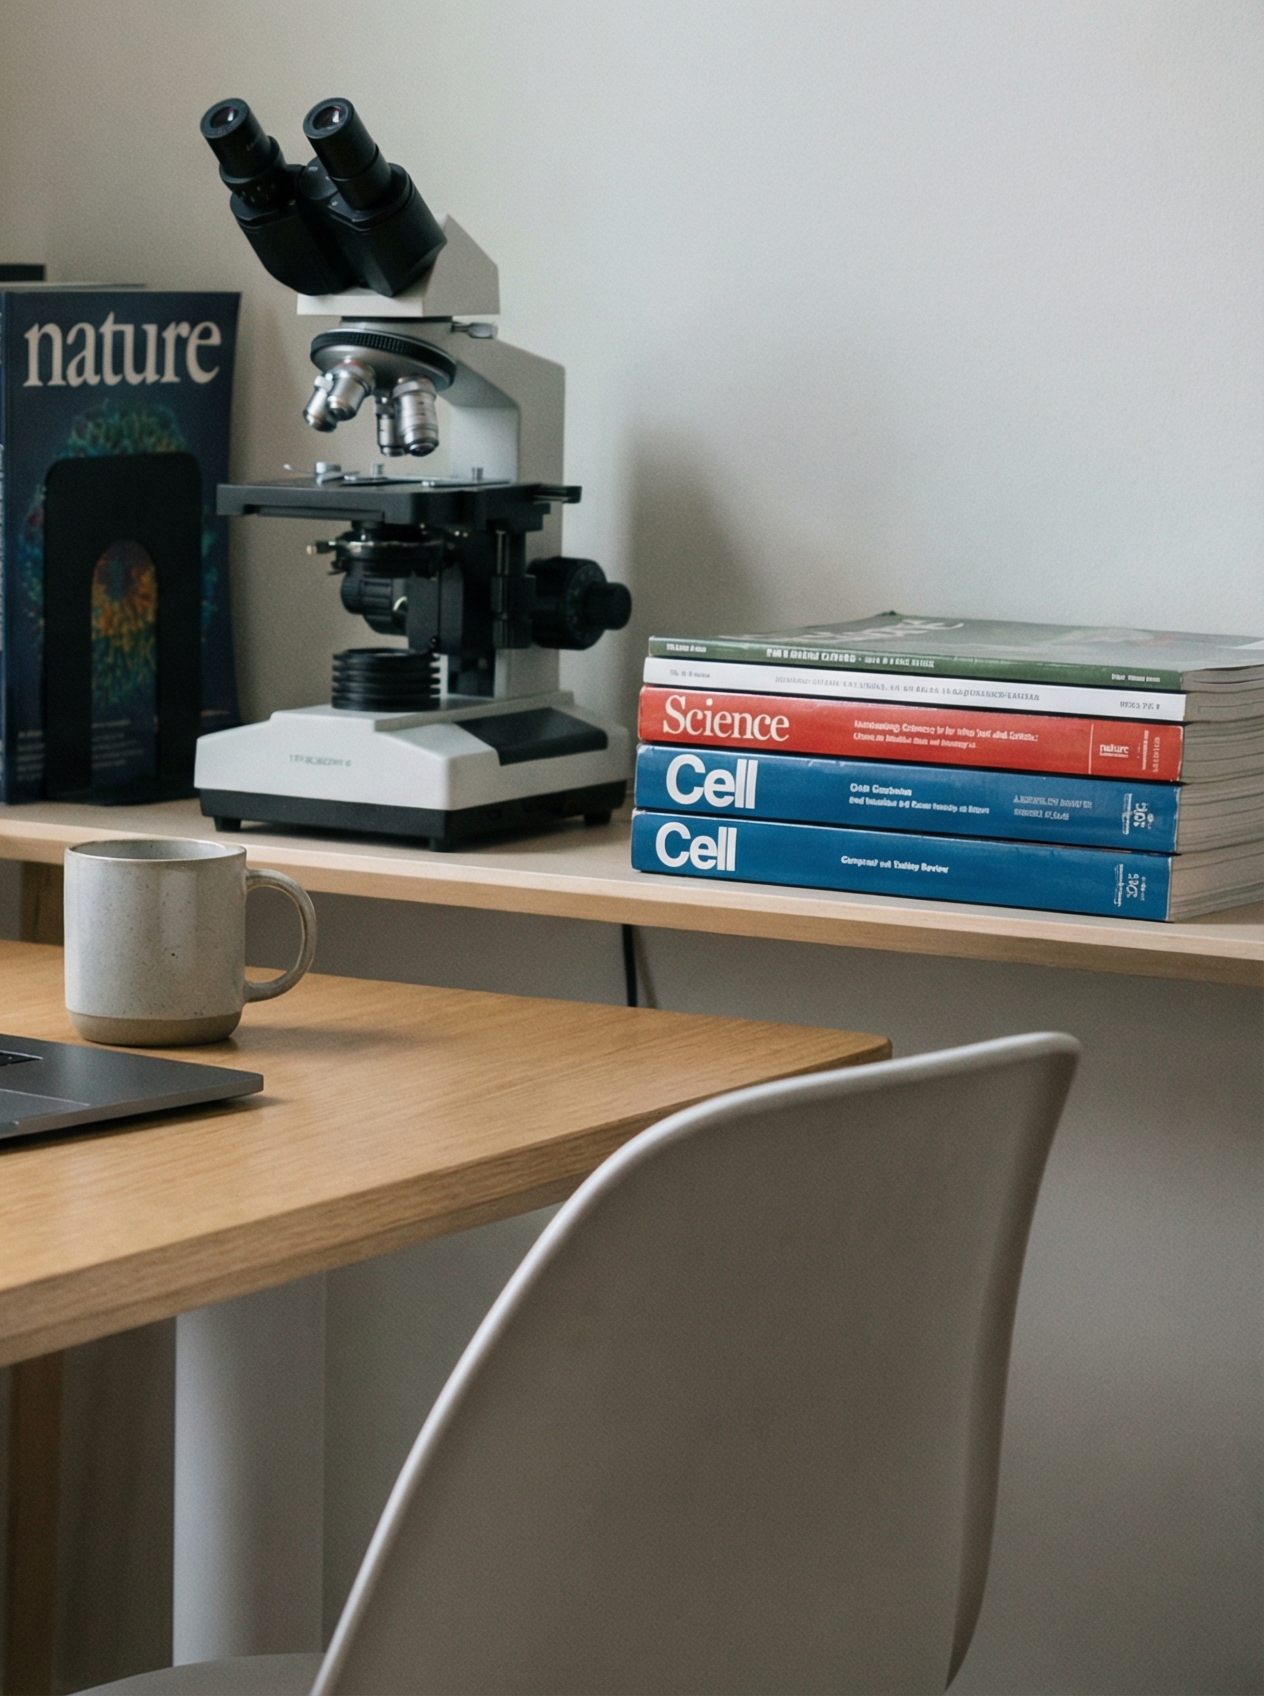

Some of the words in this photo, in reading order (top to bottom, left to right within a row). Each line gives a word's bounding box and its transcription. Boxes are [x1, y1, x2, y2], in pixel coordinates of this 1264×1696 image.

[22, 310, 223, 388] nature
[662, 694, 790, 742] Science
[666, 754, 758, 809] Cell
[654, 821, 737, 872] Cell
